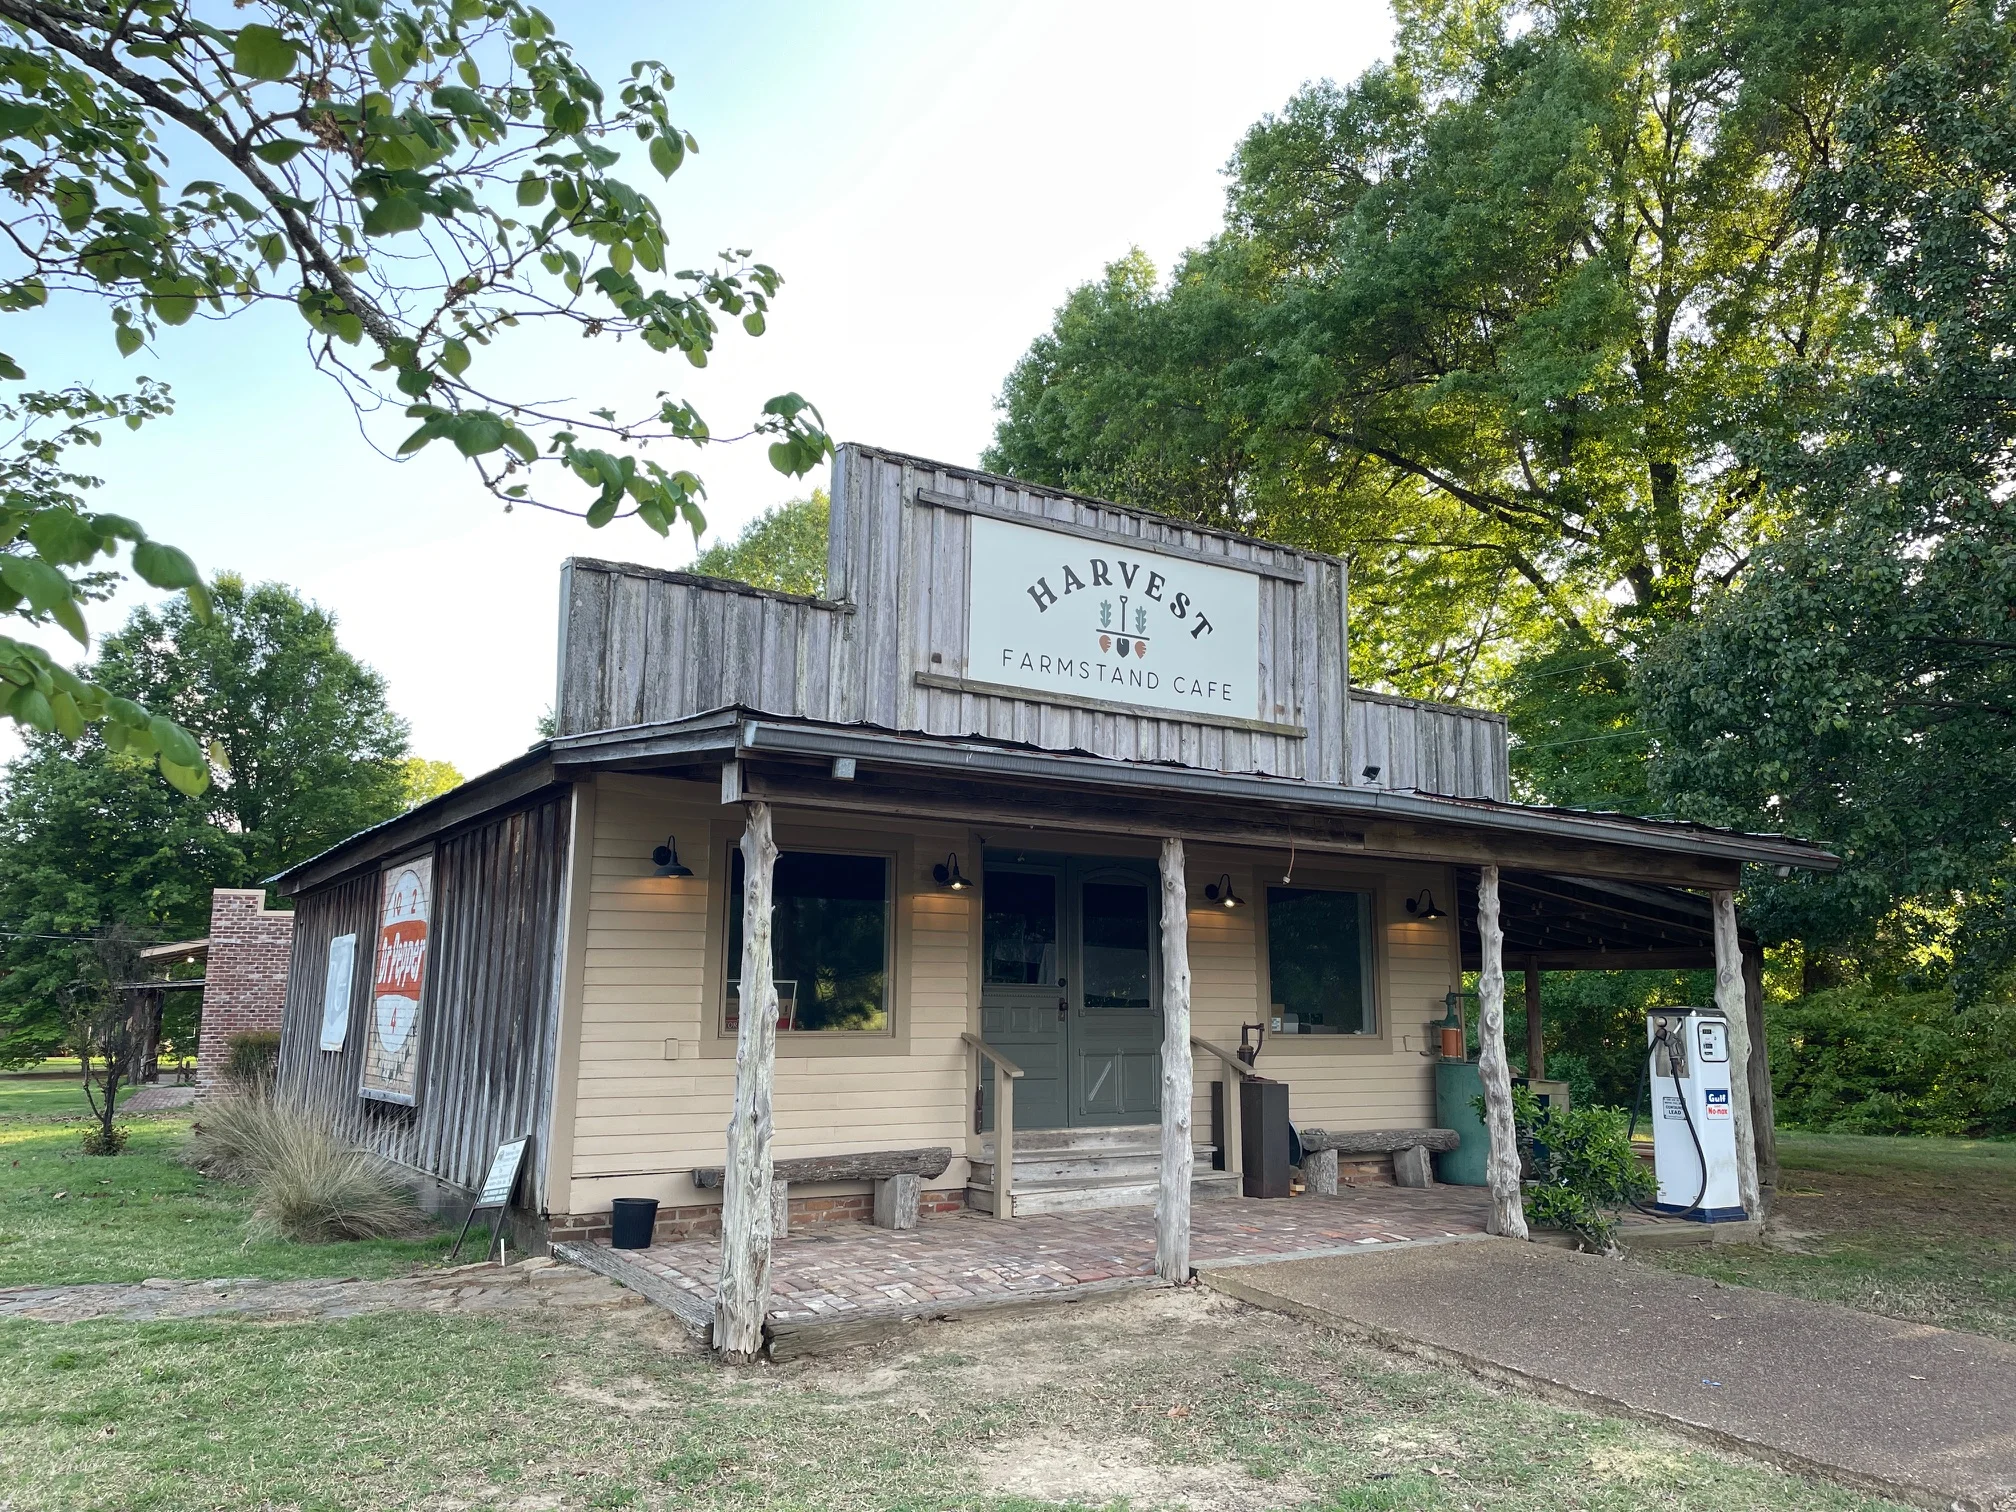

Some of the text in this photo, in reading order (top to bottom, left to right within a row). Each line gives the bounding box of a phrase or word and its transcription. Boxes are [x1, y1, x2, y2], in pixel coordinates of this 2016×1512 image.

[1026, 558, 1214, 640] HARVEST
[1002, 648, 1232, 701] FARMSTAND CAFE
[393, 888, 418, 918] 10 2
[378, 932, 426, 988] Dr Pepper
[390, 1007, 398, 1034] 4
[1708, 1093, 1726, 1103] Gulf
